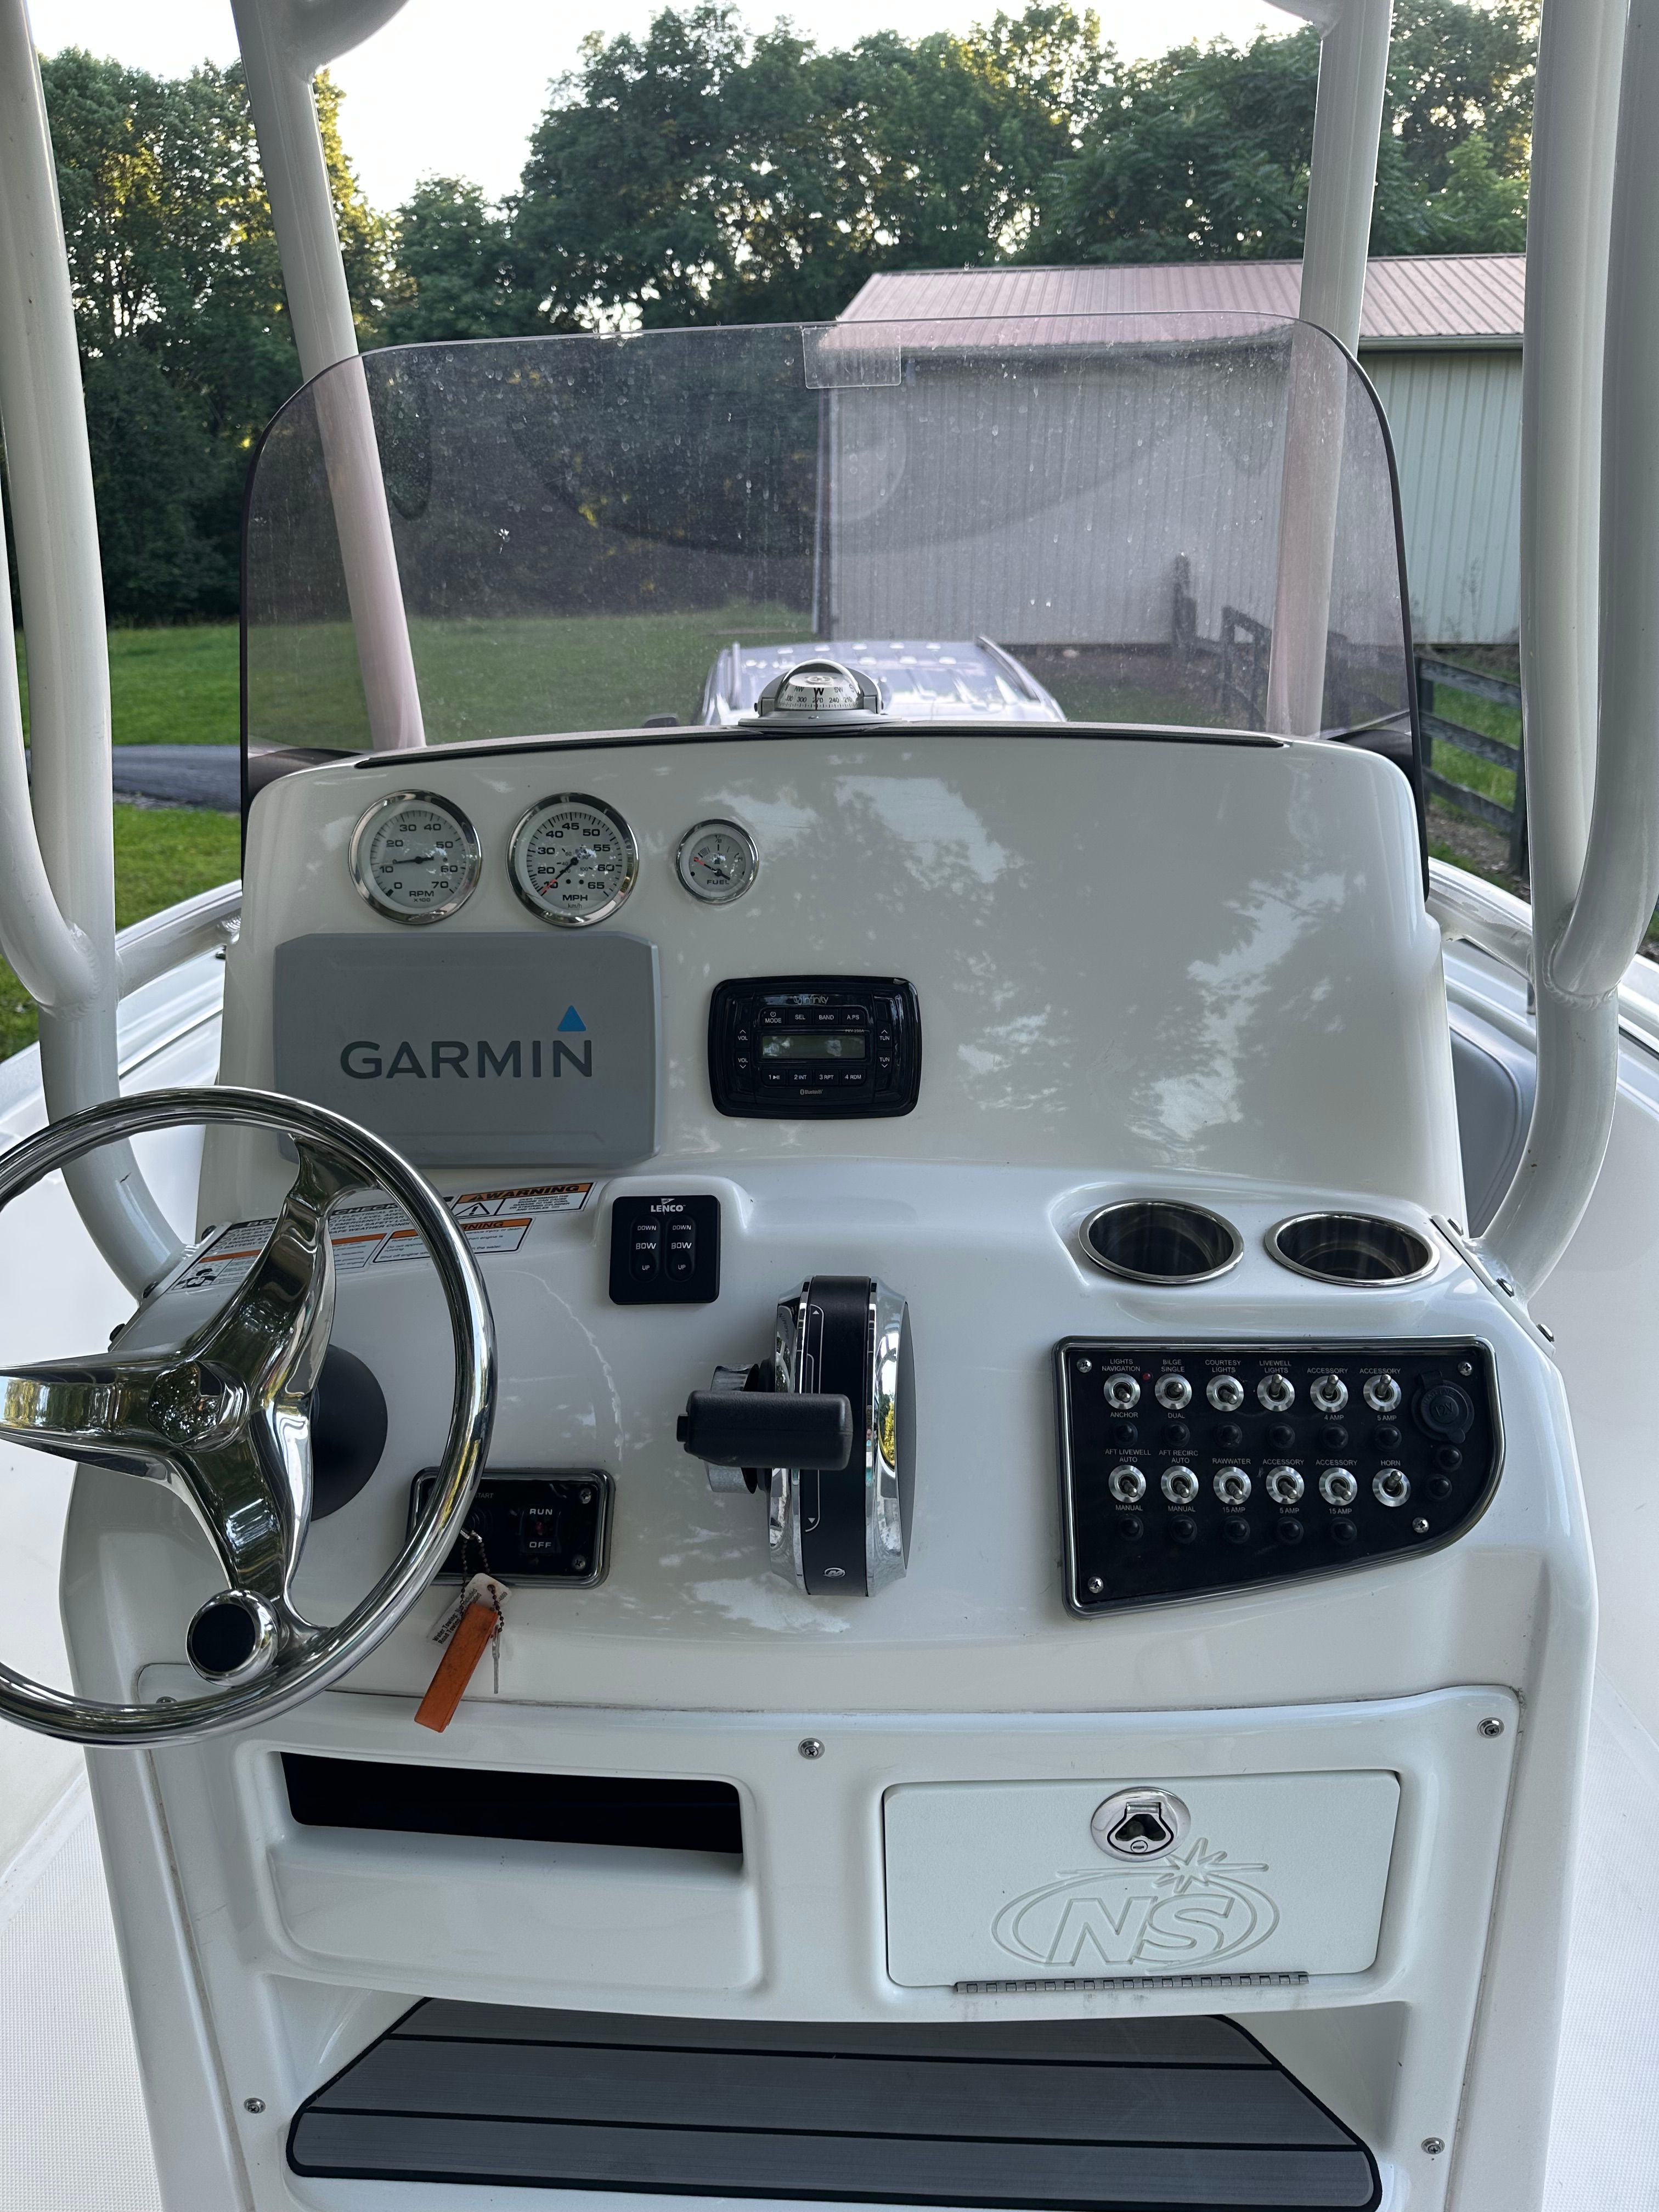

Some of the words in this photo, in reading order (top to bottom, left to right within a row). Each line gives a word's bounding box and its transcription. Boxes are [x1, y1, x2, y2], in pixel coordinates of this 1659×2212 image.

[814, 687, 824, 696] W
[386, 839, 404, 848] 20
[803, 995, 829, 1005] Infinity
[340, 1040, 592, 1079] GARMIN
[487, 1186, 579, 1199] WARNING
[651, 1205, 684, 1213] LENCO
[1434, 1402, 1453, 1417] 12V
[1046, 1894, 1235, 1966] NS
